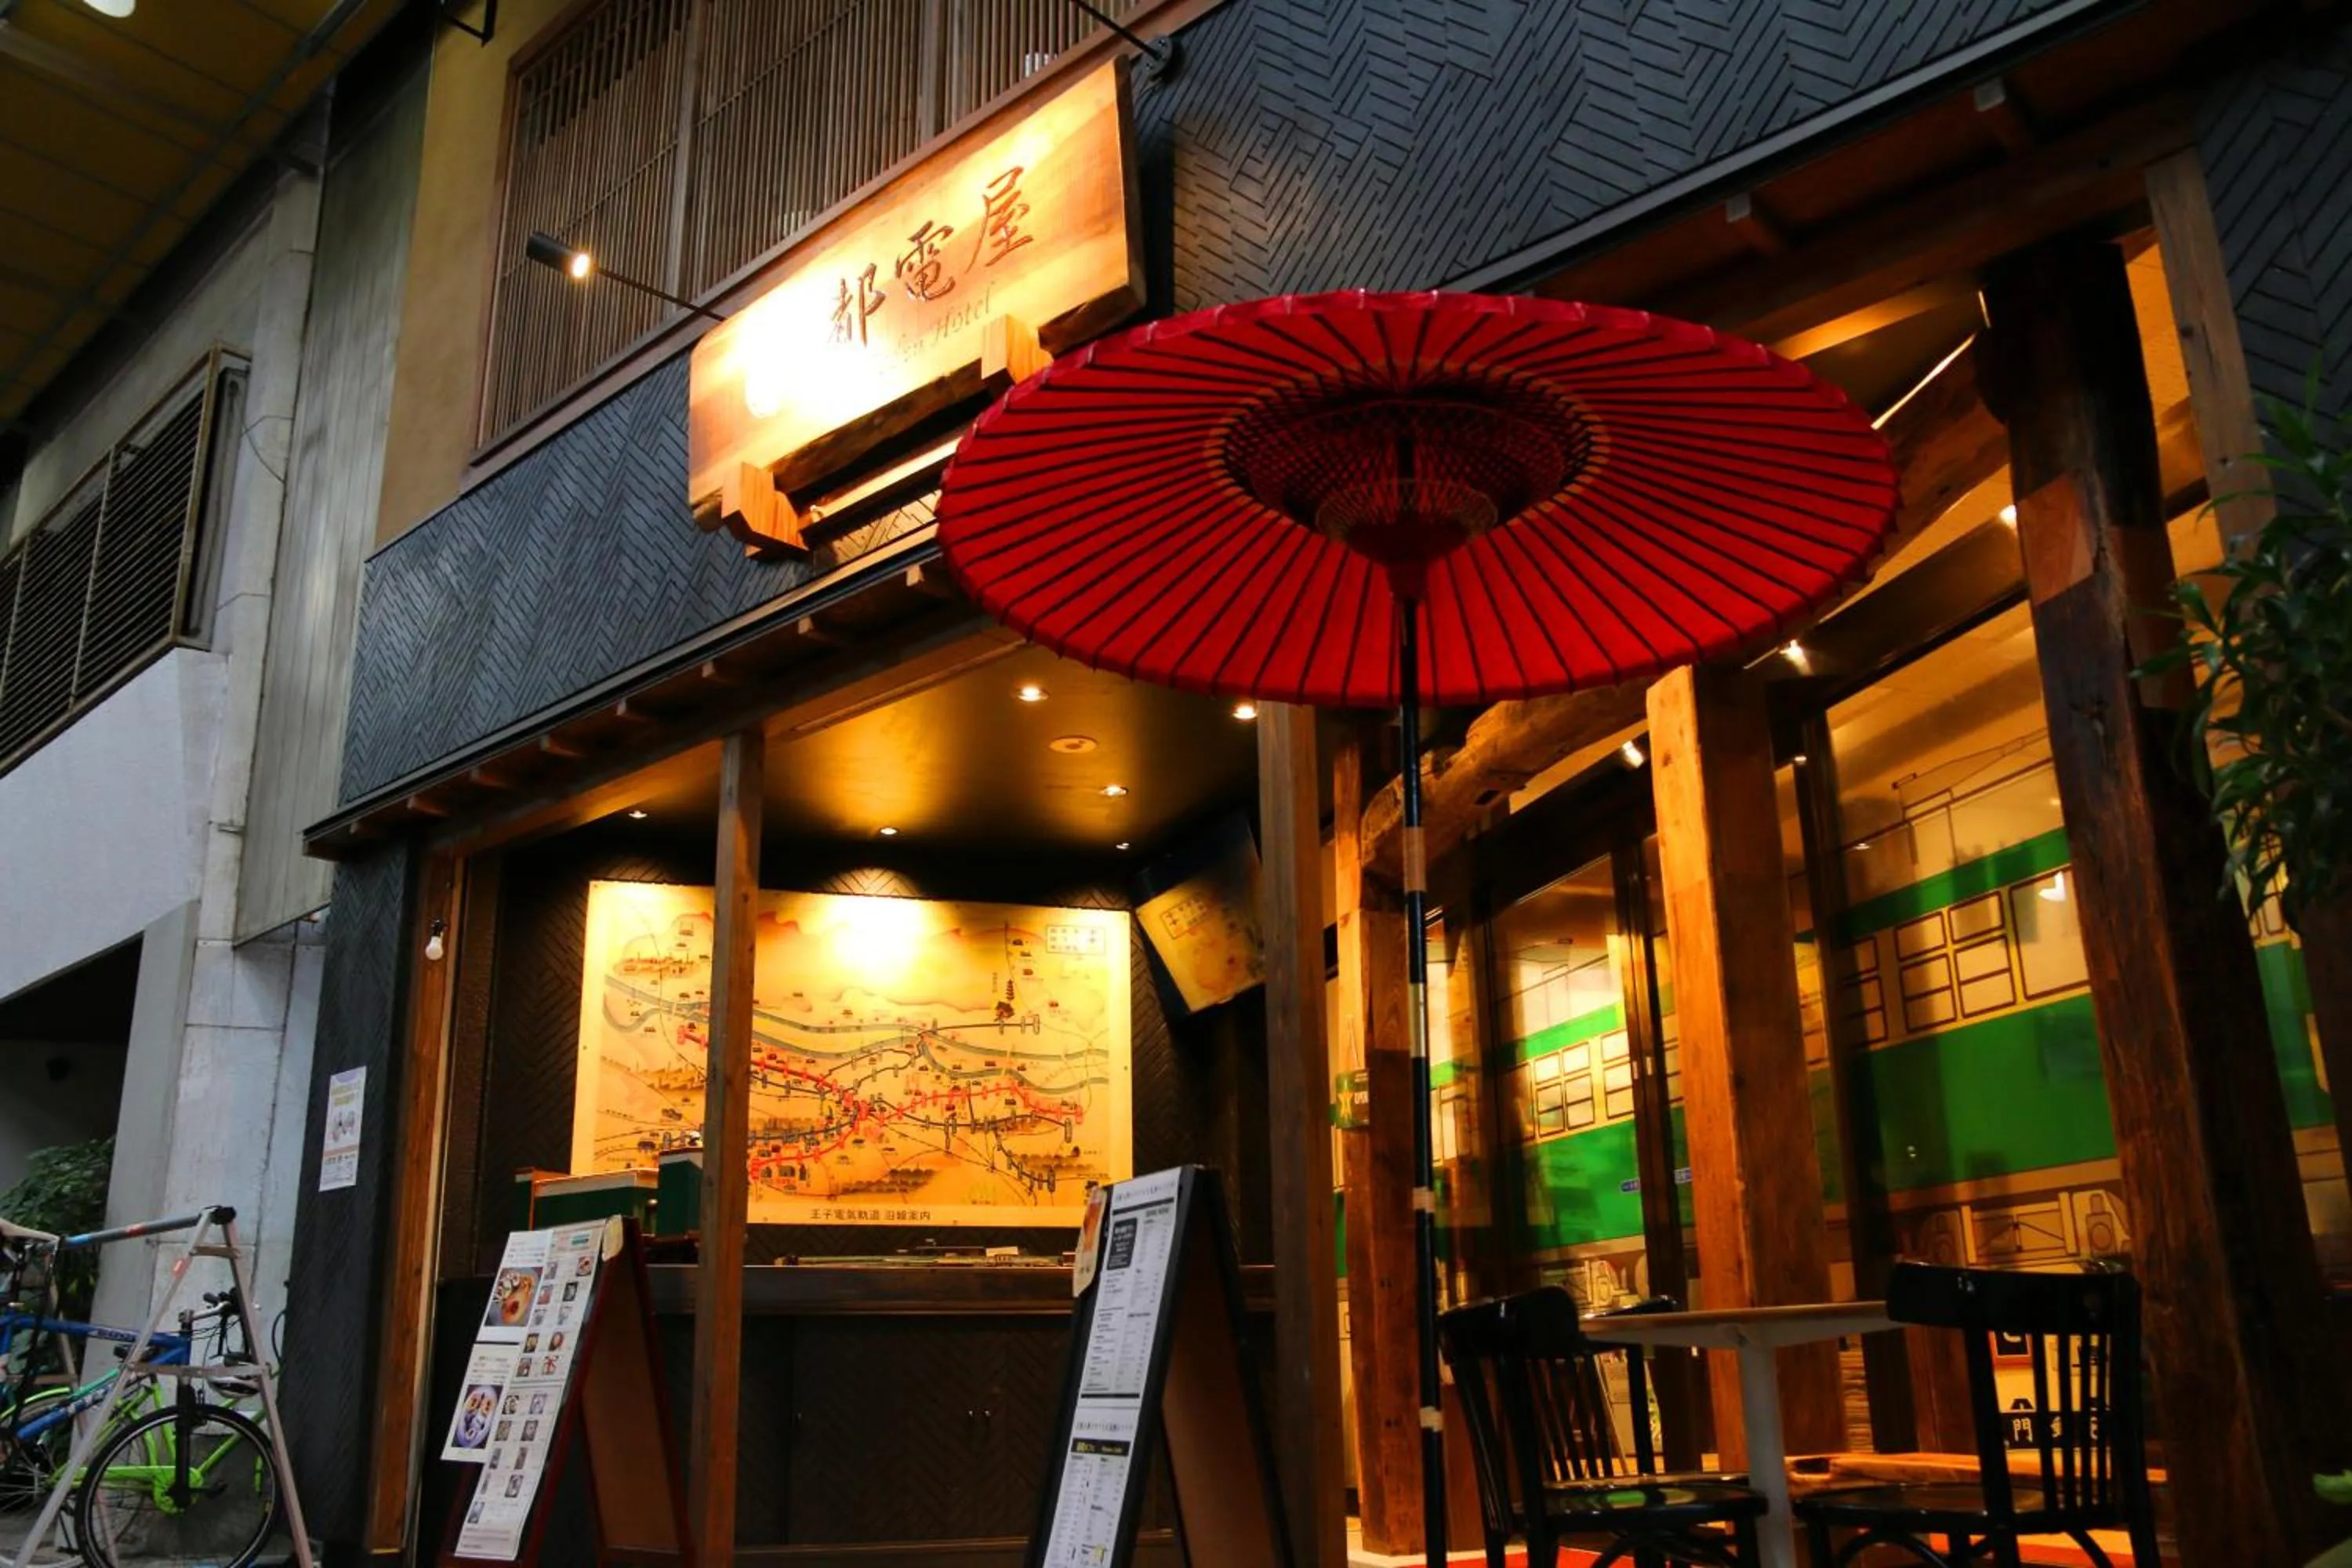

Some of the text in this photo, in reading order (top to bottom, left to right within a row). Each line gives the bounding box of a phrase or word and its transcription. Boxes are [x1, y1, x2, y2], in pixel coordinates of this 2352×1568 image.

[828, 165, 1033, 347] 都電屋
[932, 281, 996, 345] Hotel
